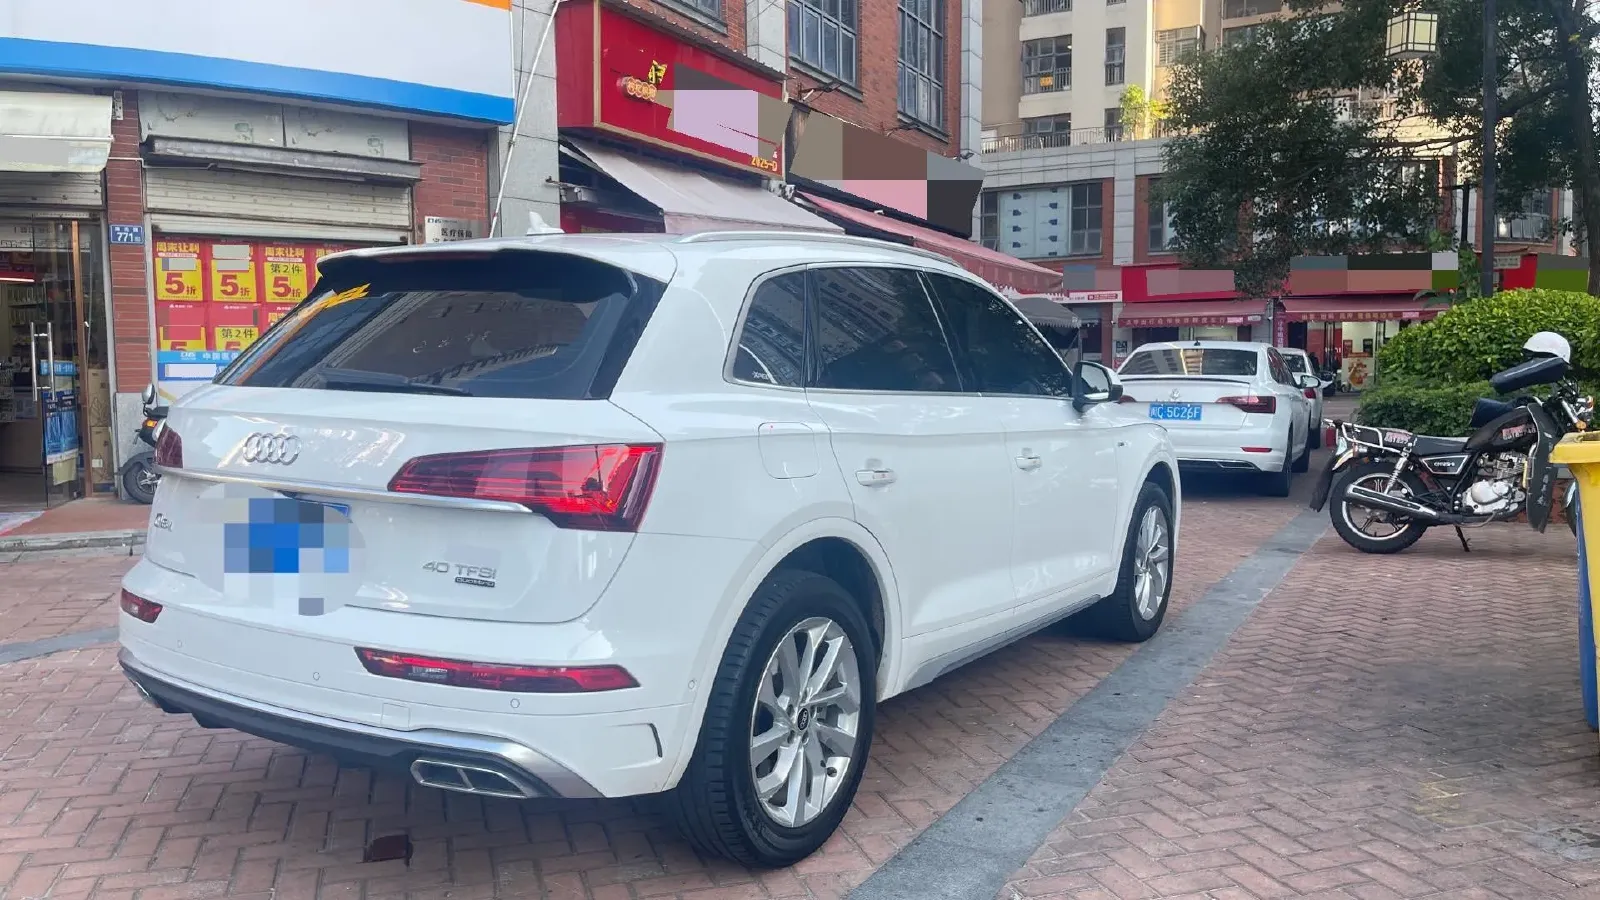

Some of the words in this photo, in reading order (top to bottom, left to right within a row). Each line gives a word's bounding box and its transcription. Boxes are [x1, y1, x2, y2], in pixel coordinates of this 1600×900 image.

[117, 232, 134, 241] 771
[270, 263, 301, 274] 第2件
[221, 328, 254, 339] 第2件
[422, 561, 449, 573] 40
[455, 563, 497, 580] TFSI
